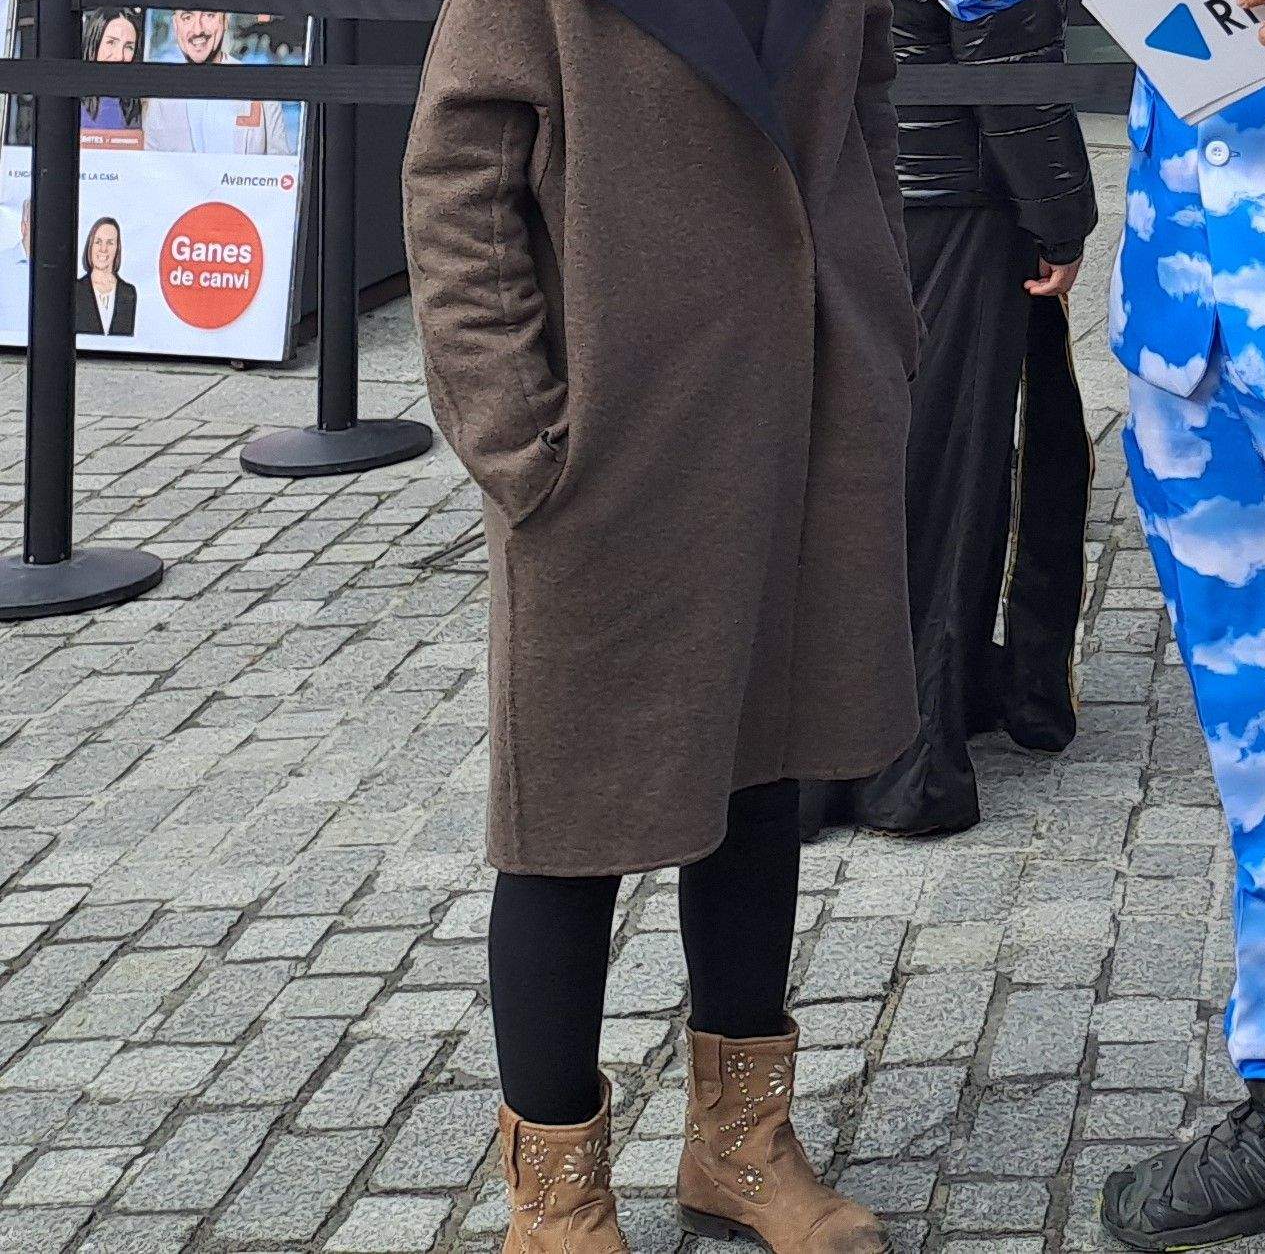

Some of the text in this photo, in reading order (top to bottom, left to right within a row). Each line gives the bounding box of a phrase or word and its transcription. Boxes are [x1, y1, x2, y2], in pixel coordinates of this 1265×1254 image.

[221, 173, 278, 187] Avancem
[171, 235, 252, 264] Ganes
[169, 266, 250, 289] de canvi
